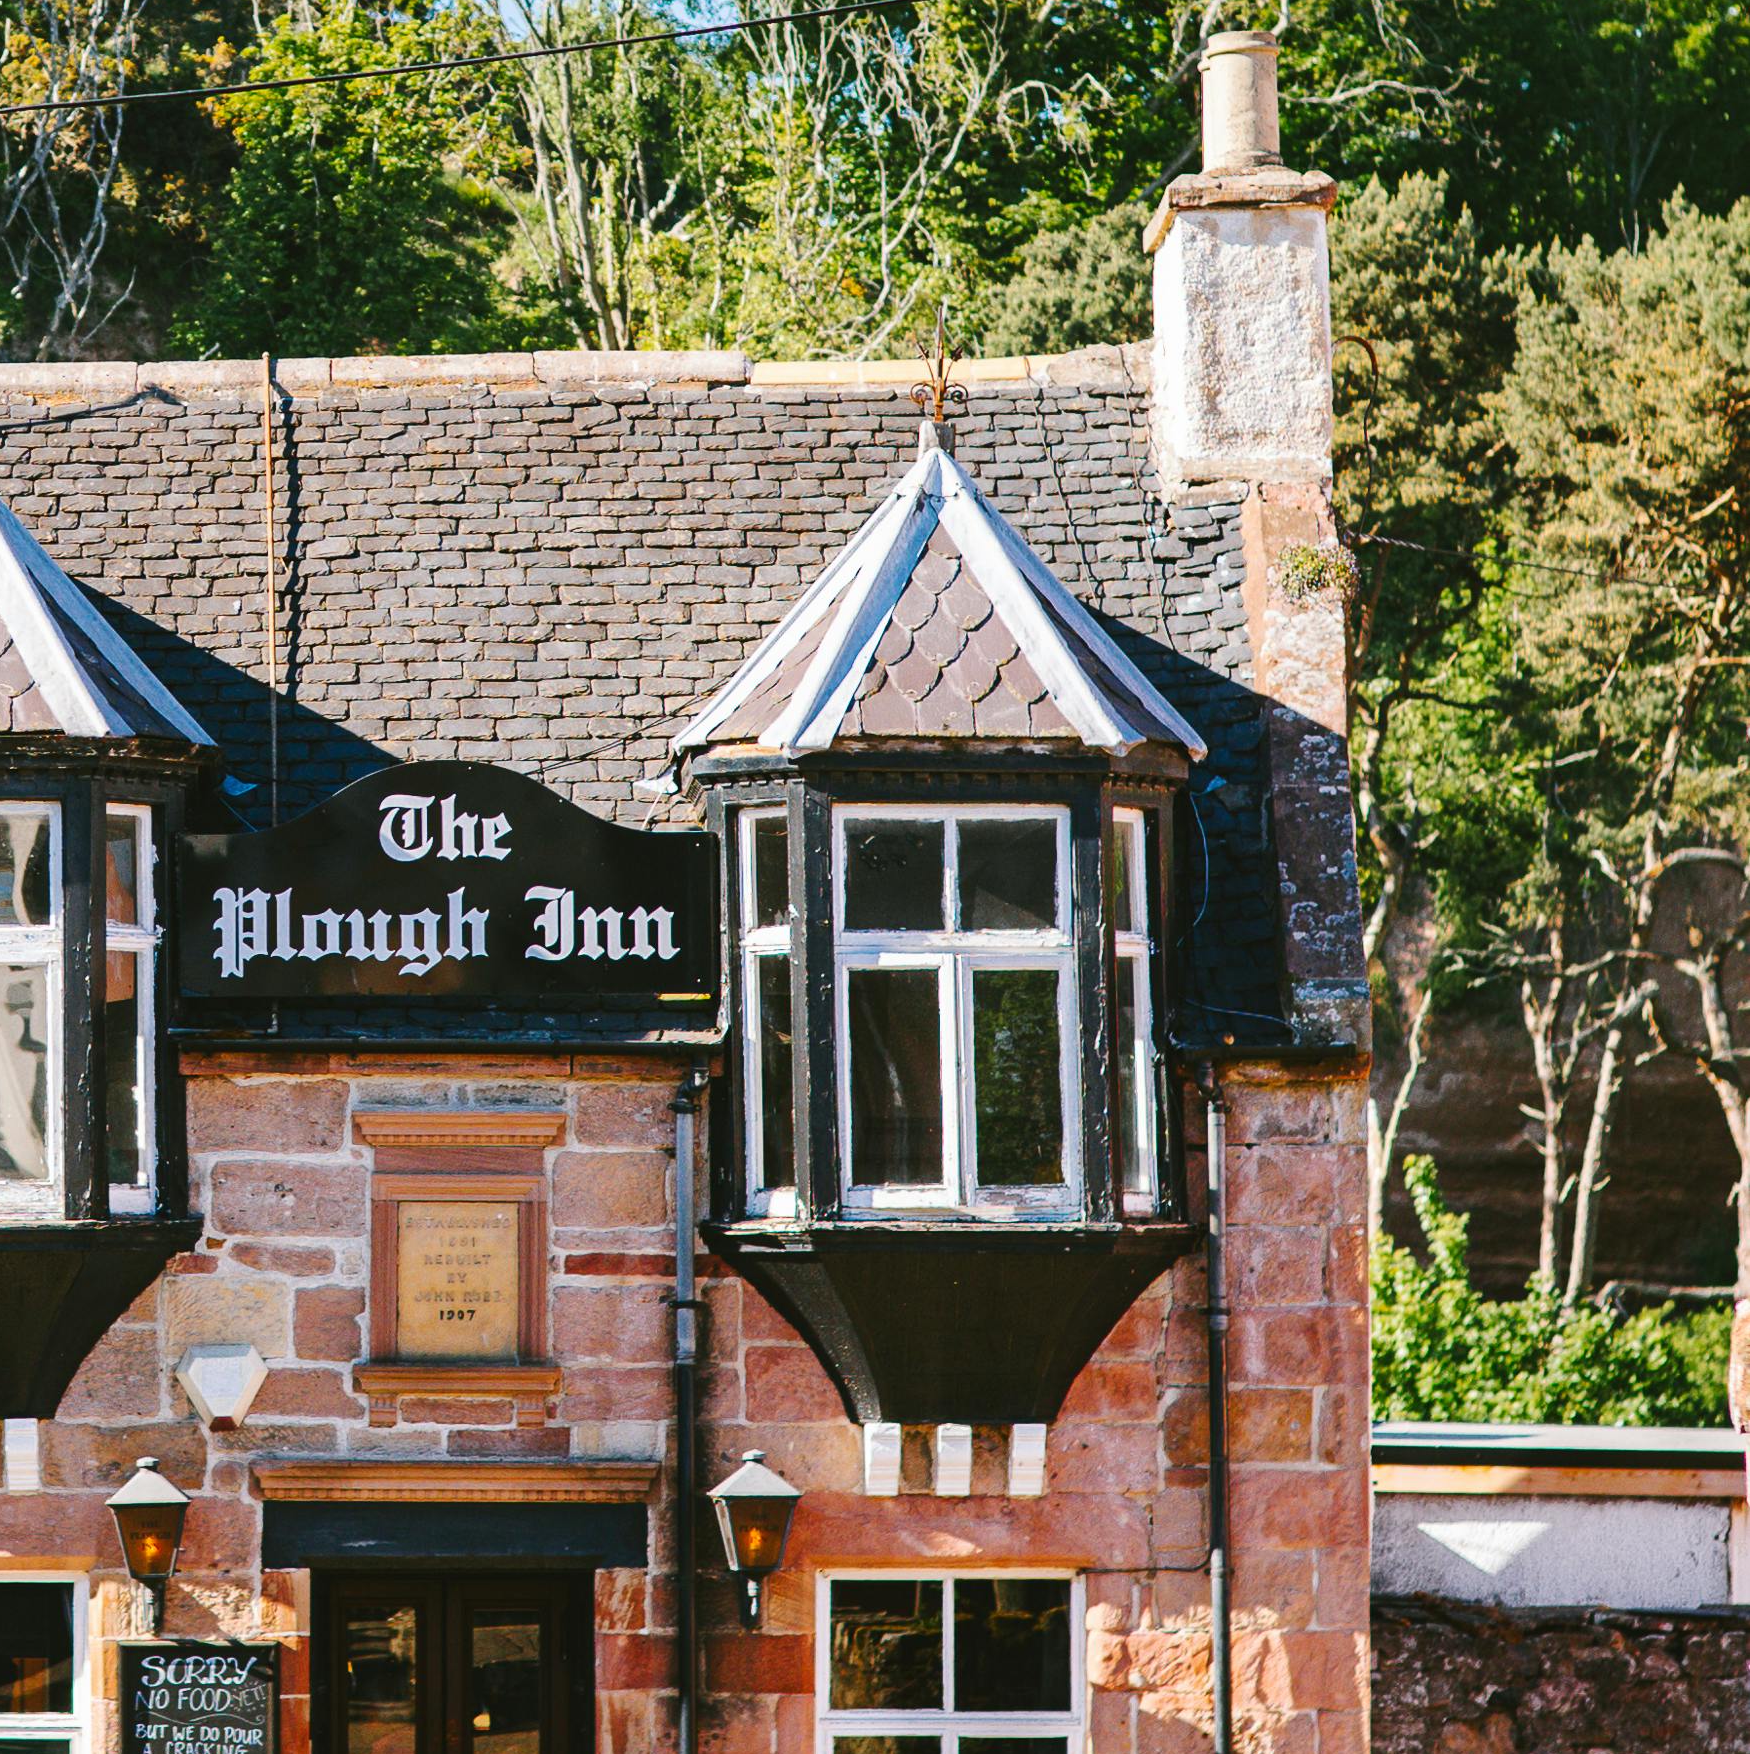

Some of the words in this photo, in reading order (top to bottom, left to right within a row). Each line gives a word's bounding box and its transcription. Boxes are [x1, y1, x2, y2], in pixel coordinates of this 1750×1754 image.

[378, 793, 513, 863] The
[212, 886, 490, 979] Plough
[524, 885, 682, 962] Inn
[439, 1309, 477, 1321] 1907
[141, 1656, 257, 1687] SORRY
[135, 1690, 170, 1710] NO
[177, 1687, 231, 1711] FOOD
[231, 1685, 267, 1708] YET!
[135, 1723, 169, 1740] BUT
[172, 1726, 195, 1741] WE
[200, 1726, 220, 1741] DO
[224, 1727, 263, 1746] POUR
